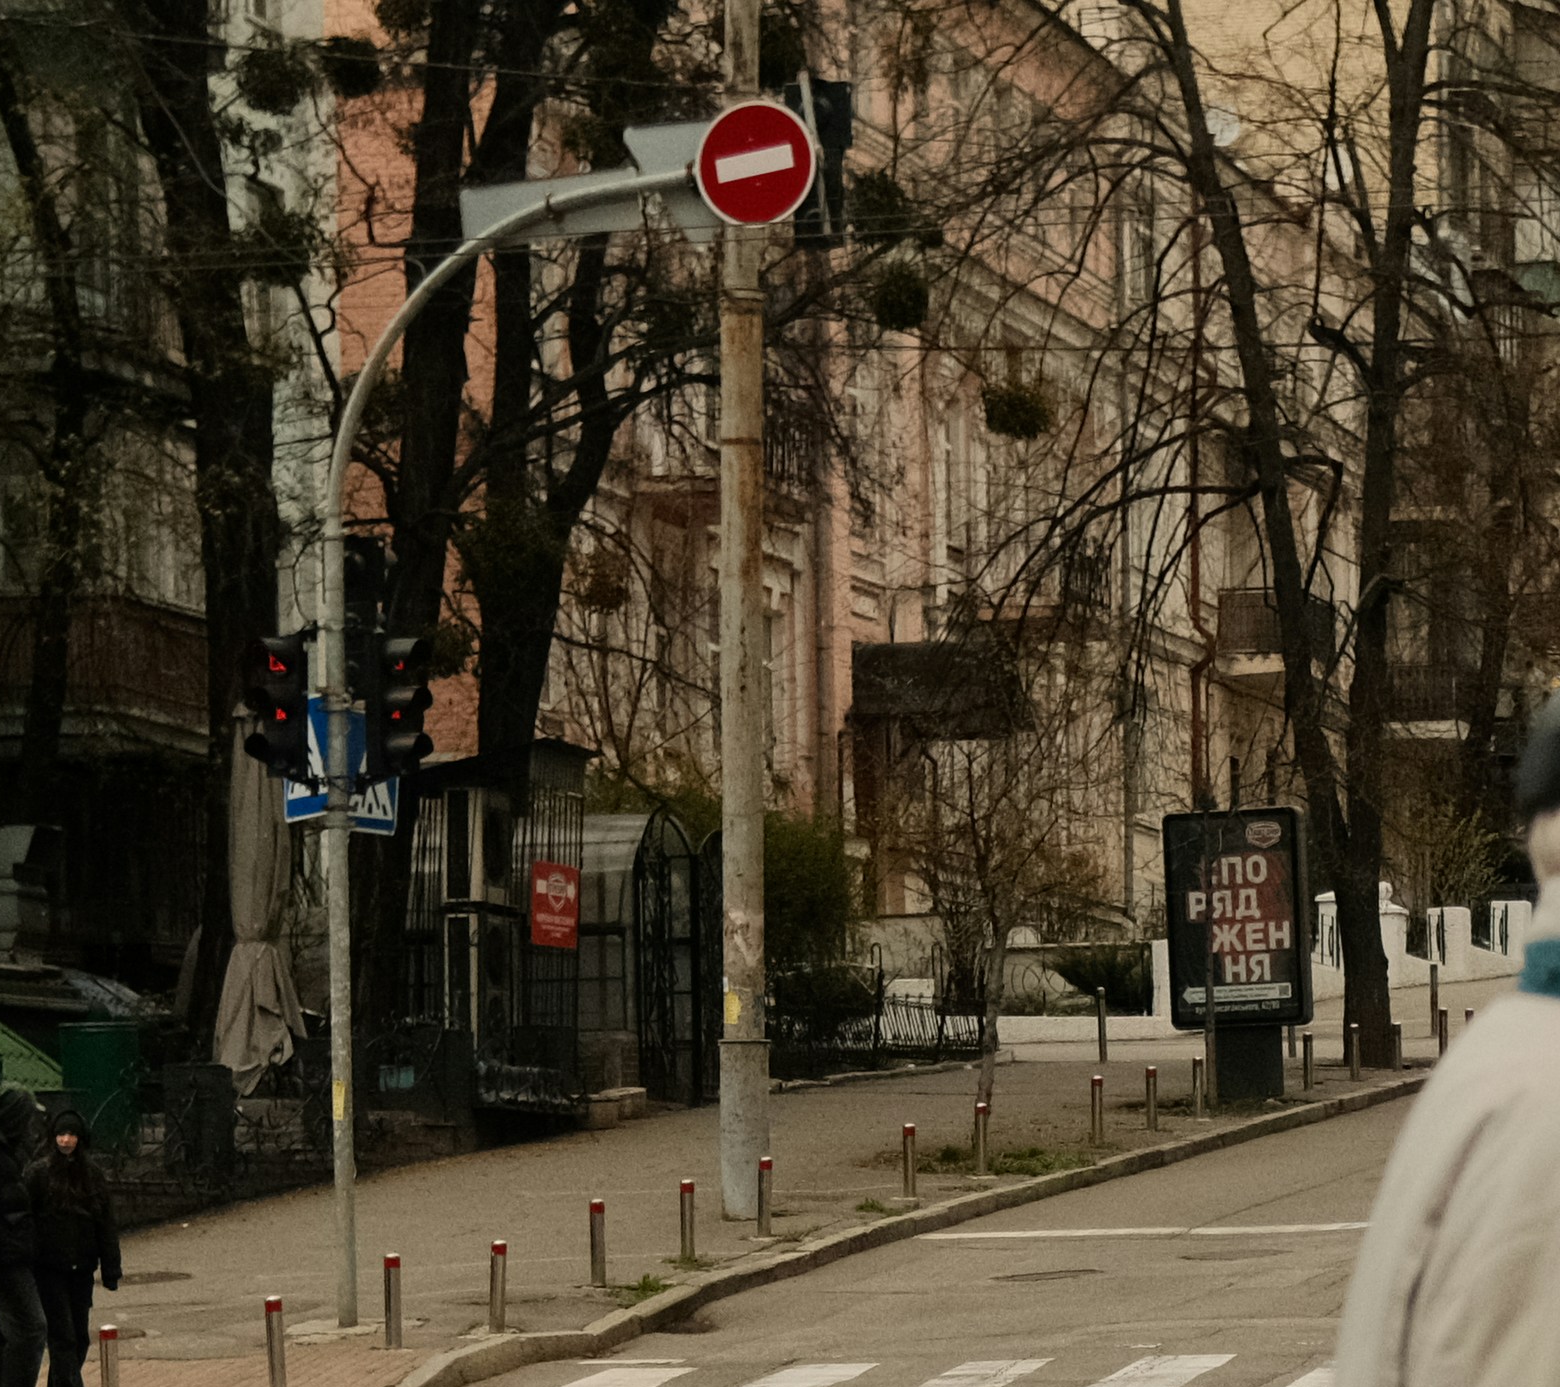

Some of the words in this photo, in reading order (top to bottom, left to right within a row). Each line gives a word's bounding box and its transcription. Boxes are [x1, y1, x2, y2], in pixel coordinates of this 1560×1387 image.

[1188, 888, 1261, 920] РЯД
[1211, 920, 1290, 953] ЖЕН
[1224, 953, 1271, 984] НЯ
